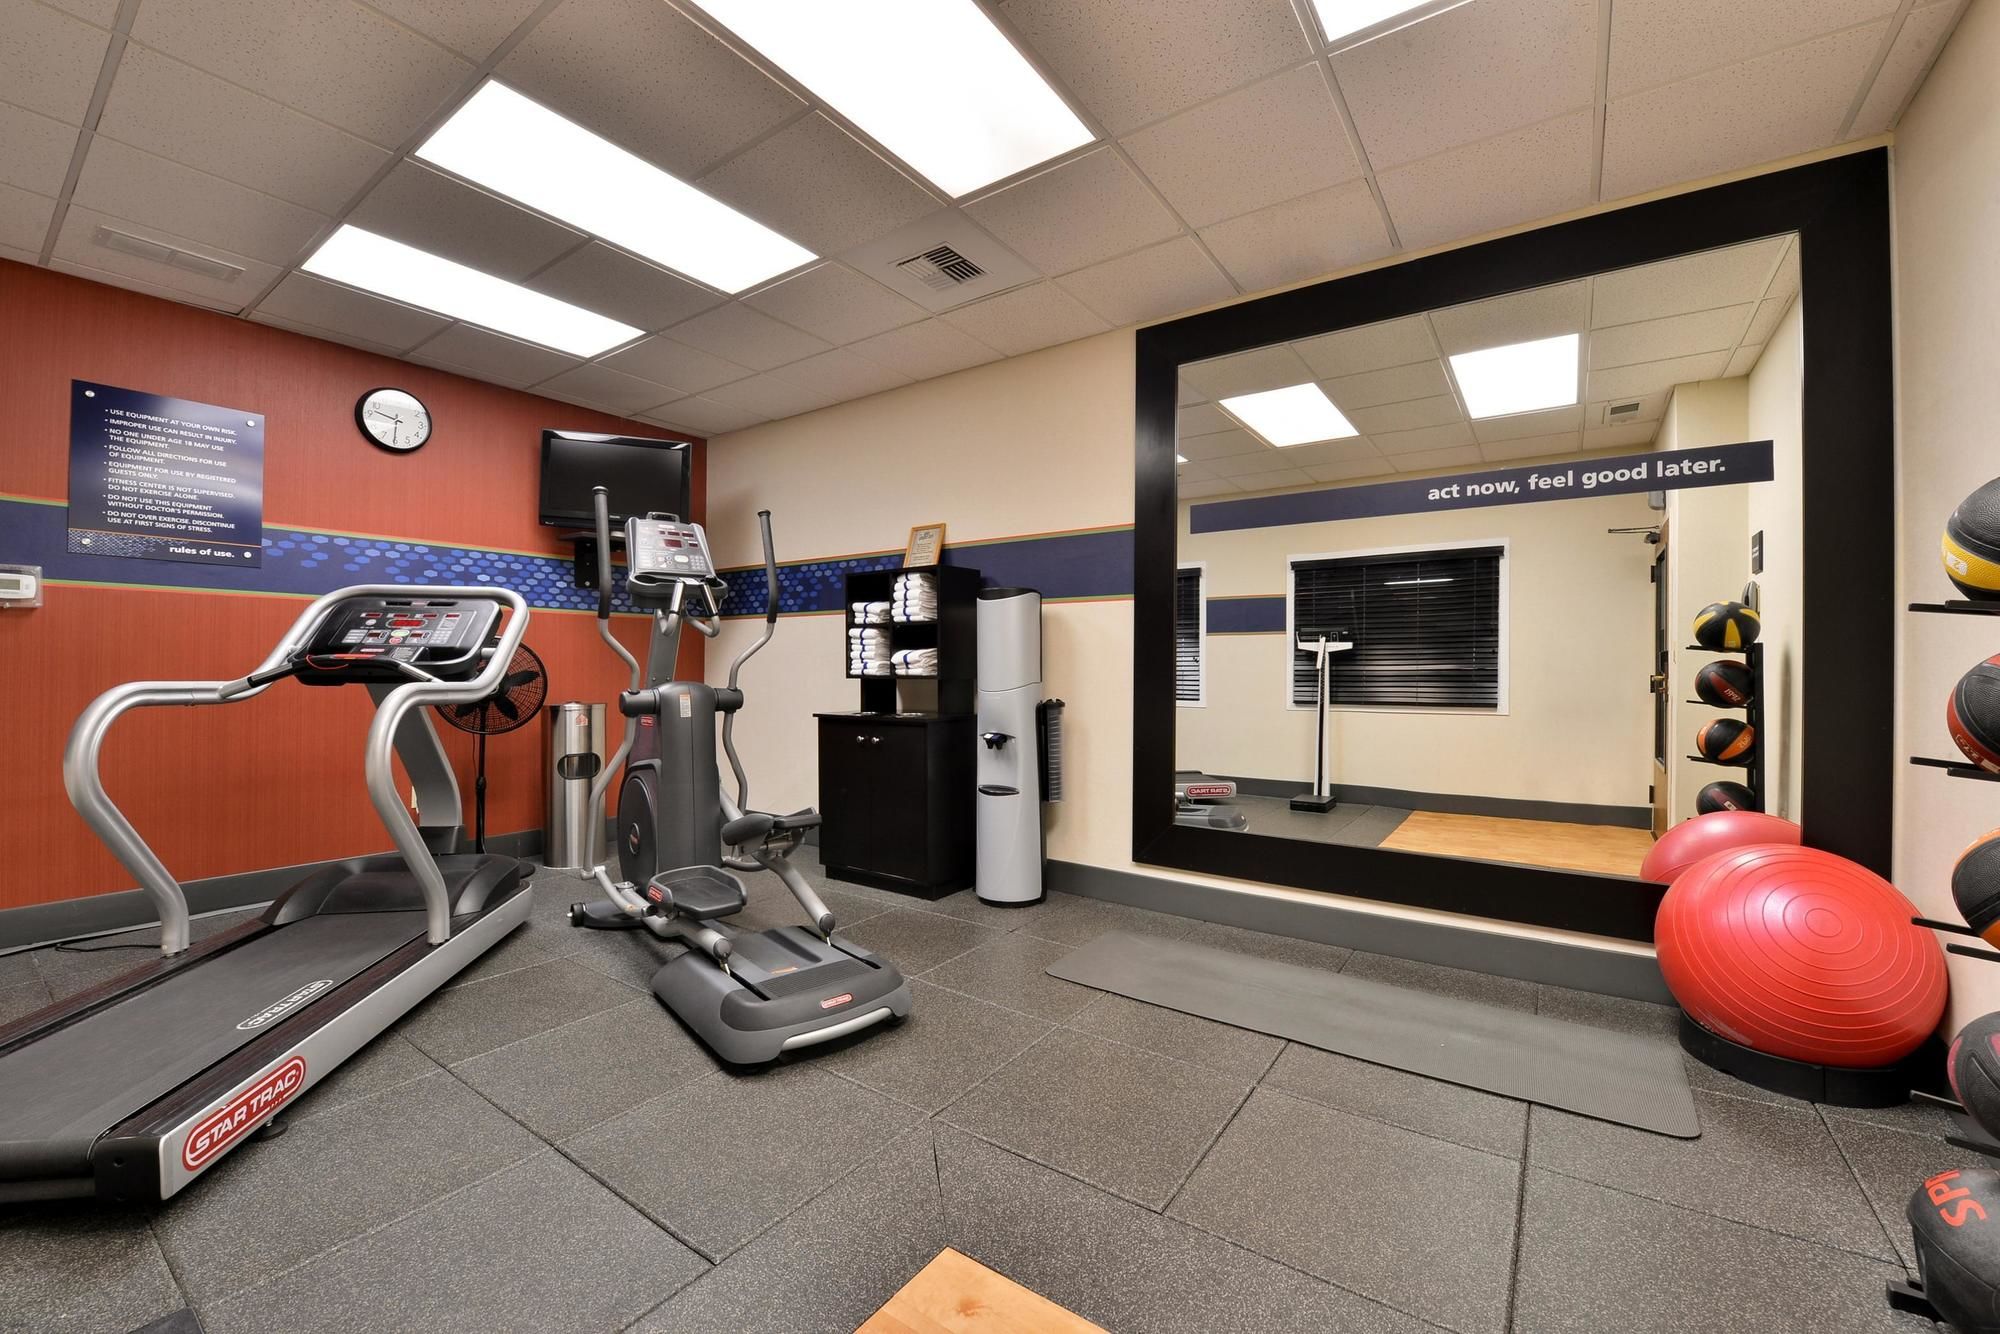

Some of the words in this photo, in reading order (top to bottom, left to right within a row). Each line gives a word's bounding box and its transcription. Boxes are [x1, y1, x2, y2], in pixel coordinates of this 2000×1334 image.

[126, 412, 168, 423] EQUIPMENT
[110, 418, 147, 429] IMPROPER
[180, 430, 203, 439] RESULT
[213, 436, 238, 444] INJURY.
[141, 433, 166, 442] UNDER
[126, 438, 170, 449] EQUIPMENT.
[109, 445, 141, 454] FOLLOW
[157, 452, 198, 462] DIRECTIONS
[121, 453, 166, 464] EQUIPMENT.
[108, 461, 152, 472] EQUIPMENT
[108, 468, 136, 476] GUESTS
[108, 478, 137, 486] FITNESS
[139, 482, 166, 490] CENTER
[1427, 484, 1460, 501] act
[1466, 479, 1520, 496] now,
[1528, 470, 1574, 490] feel
[1582, 463, 1648, 488] good
[1656, 457, 1726, 478] later.
[140, 488, 172, 497] EXERCISE
[108, 501, 144, 510] WITHOUT
[183, 509, 224, 519] PERMISSION.
[172, 501, 213, 511] EQUIPMENT
[192, 520, 235, 529] DISCONTINUE
[170, 546, 197, 554] rules
[194, 1105, 248, 1152] STAR
[250, 1069, 296, 1113] TRAC
